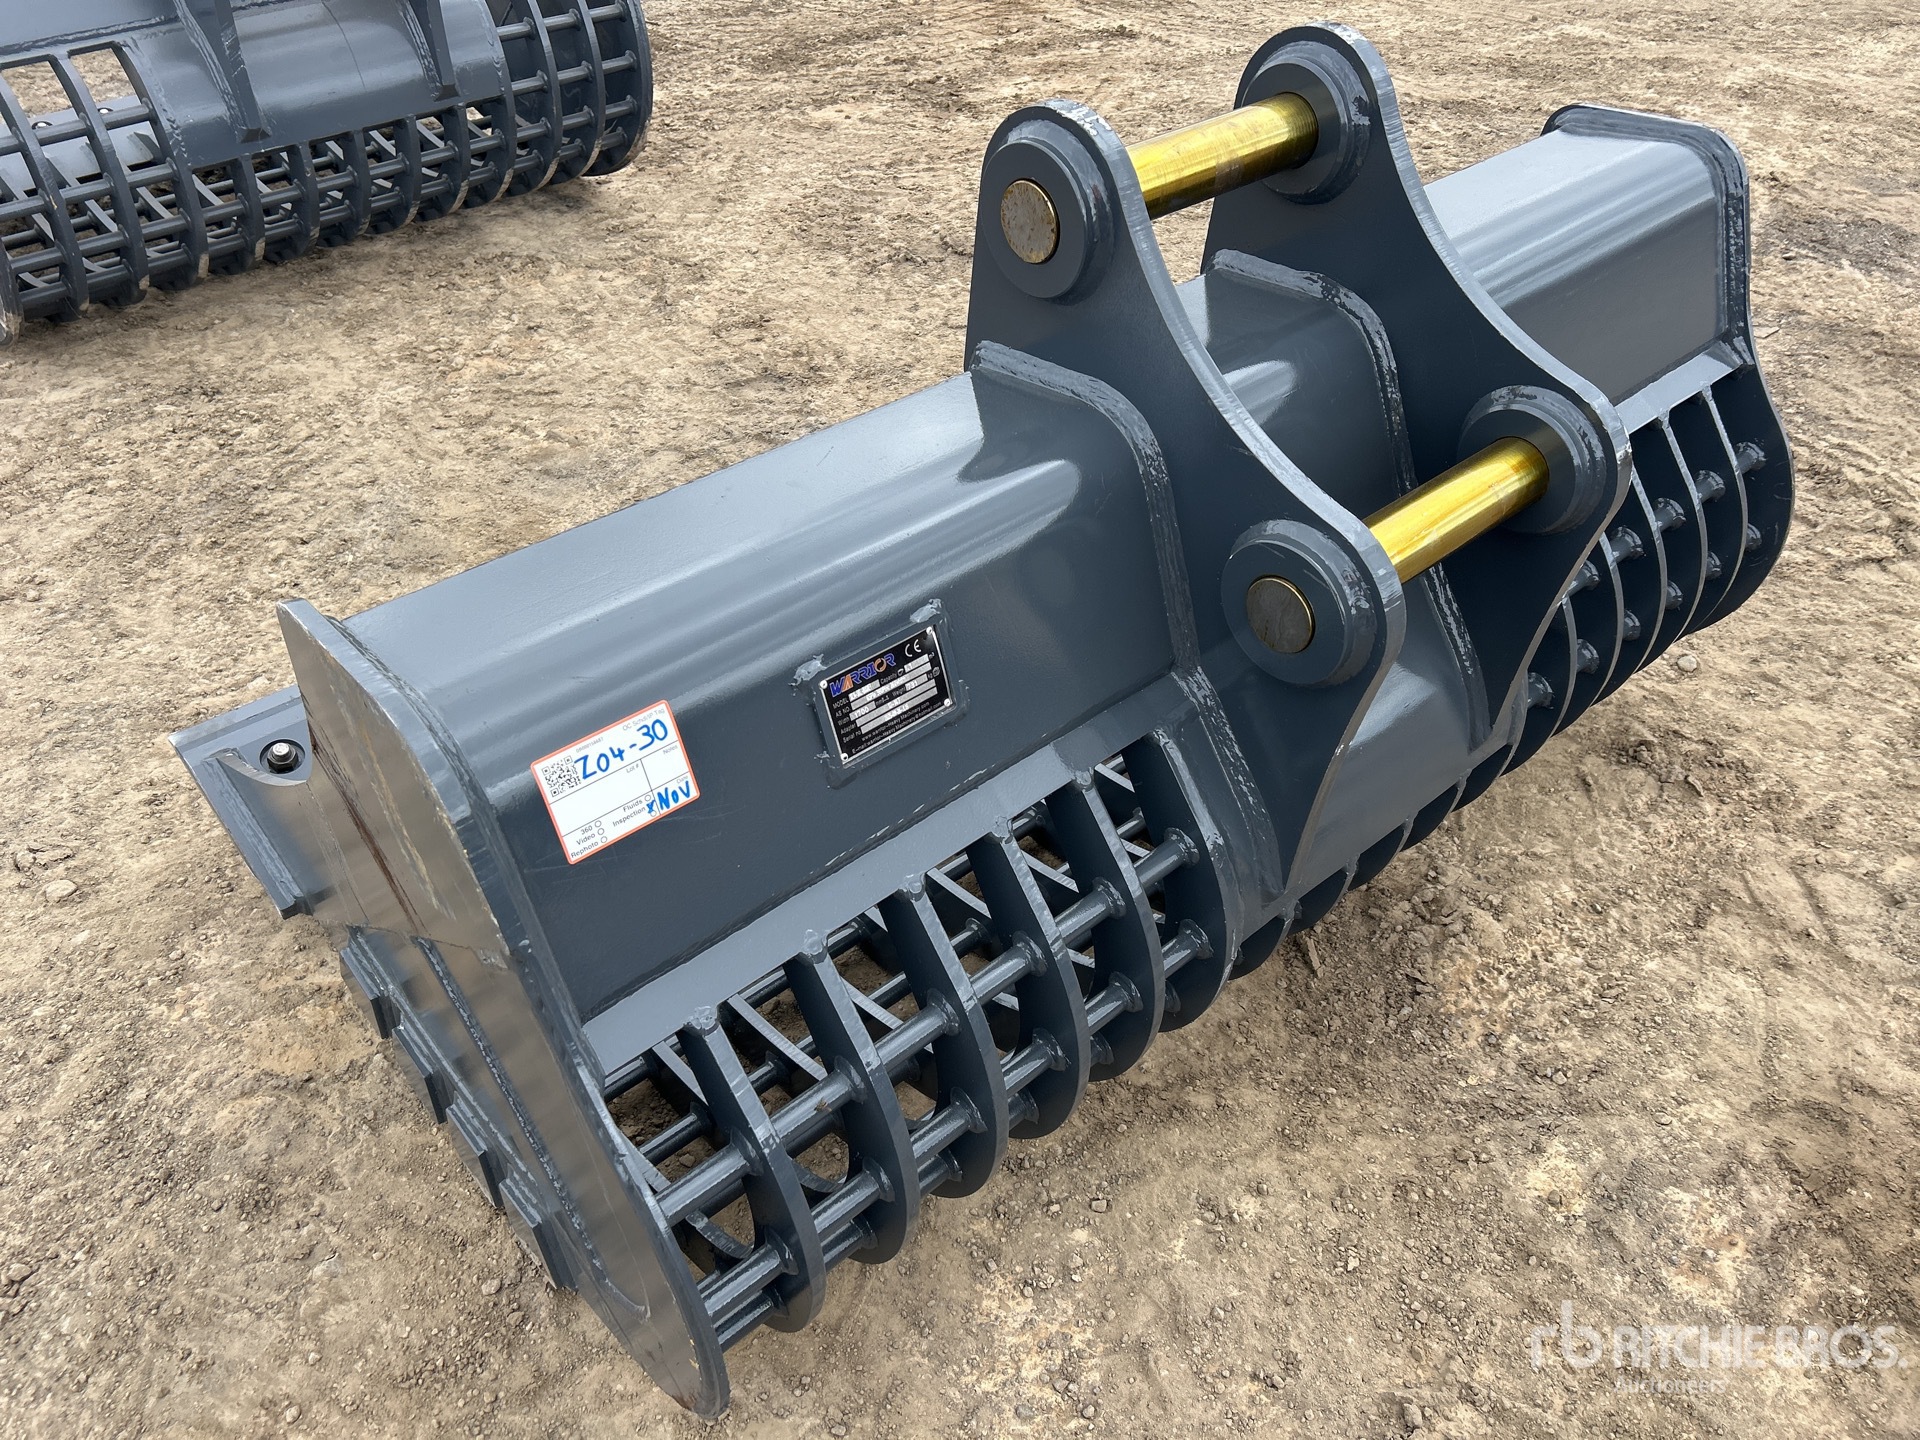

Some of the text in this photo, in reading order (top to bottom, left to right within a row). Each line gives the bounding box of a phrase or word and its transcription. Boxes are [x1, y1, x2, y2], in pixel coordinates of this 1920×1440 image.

[904, 639, 921, 657] CE
[829, 653, 896, 697] WARRIOR
[832, 697, 848, 709] MODEL
[854, 705, 869, 718] 1700
[663, 743, 678, 754] Notes
[625, 765, 635, 773] Lot
[622, 798, 642, 812] Fluids
[612, 805, 646, 828] Inspection
[580, 824, 593, 835] 360
[576, 831, 595, 846] Video
[570, 839, 599, 860] Rephoto
